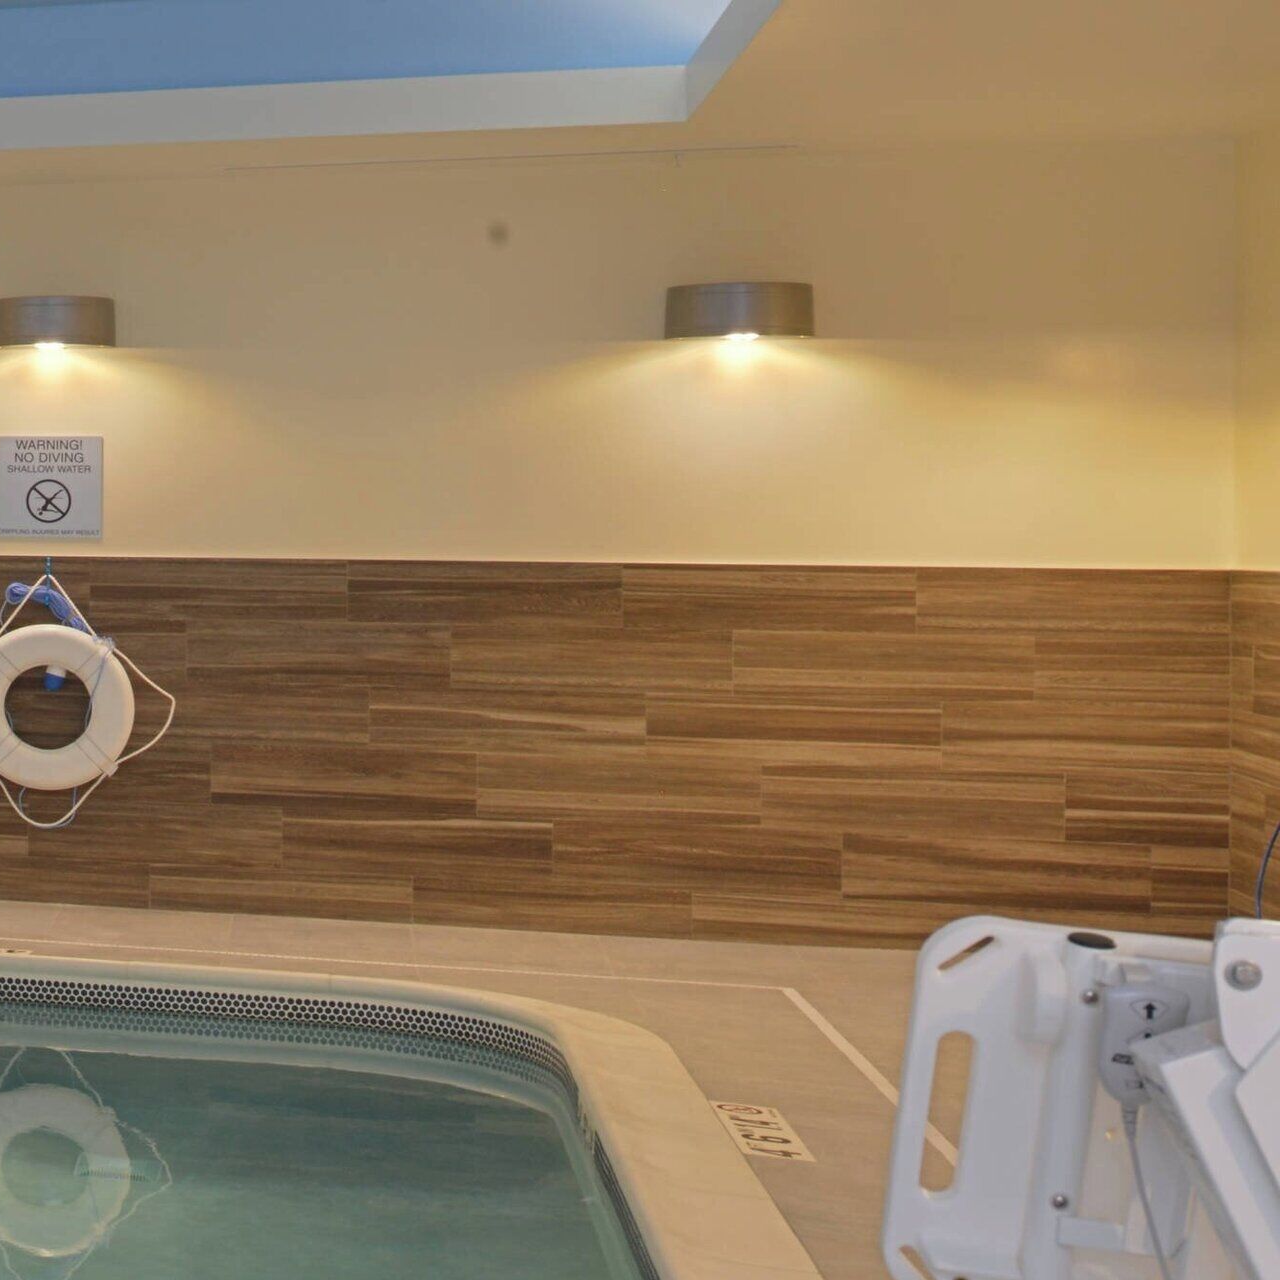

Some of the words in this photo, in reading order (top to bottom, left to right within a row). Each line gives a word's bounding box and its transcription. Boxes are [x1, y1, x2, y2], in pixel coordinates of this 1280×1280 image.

[15, 439, 83, 451] WARNING!
[14, 452, 35, 463] NO
[39, 452, 84, 463] DIVING
[7, 464, 55, 473] SHALLOW
[57, 464, 92, 473] WATER
